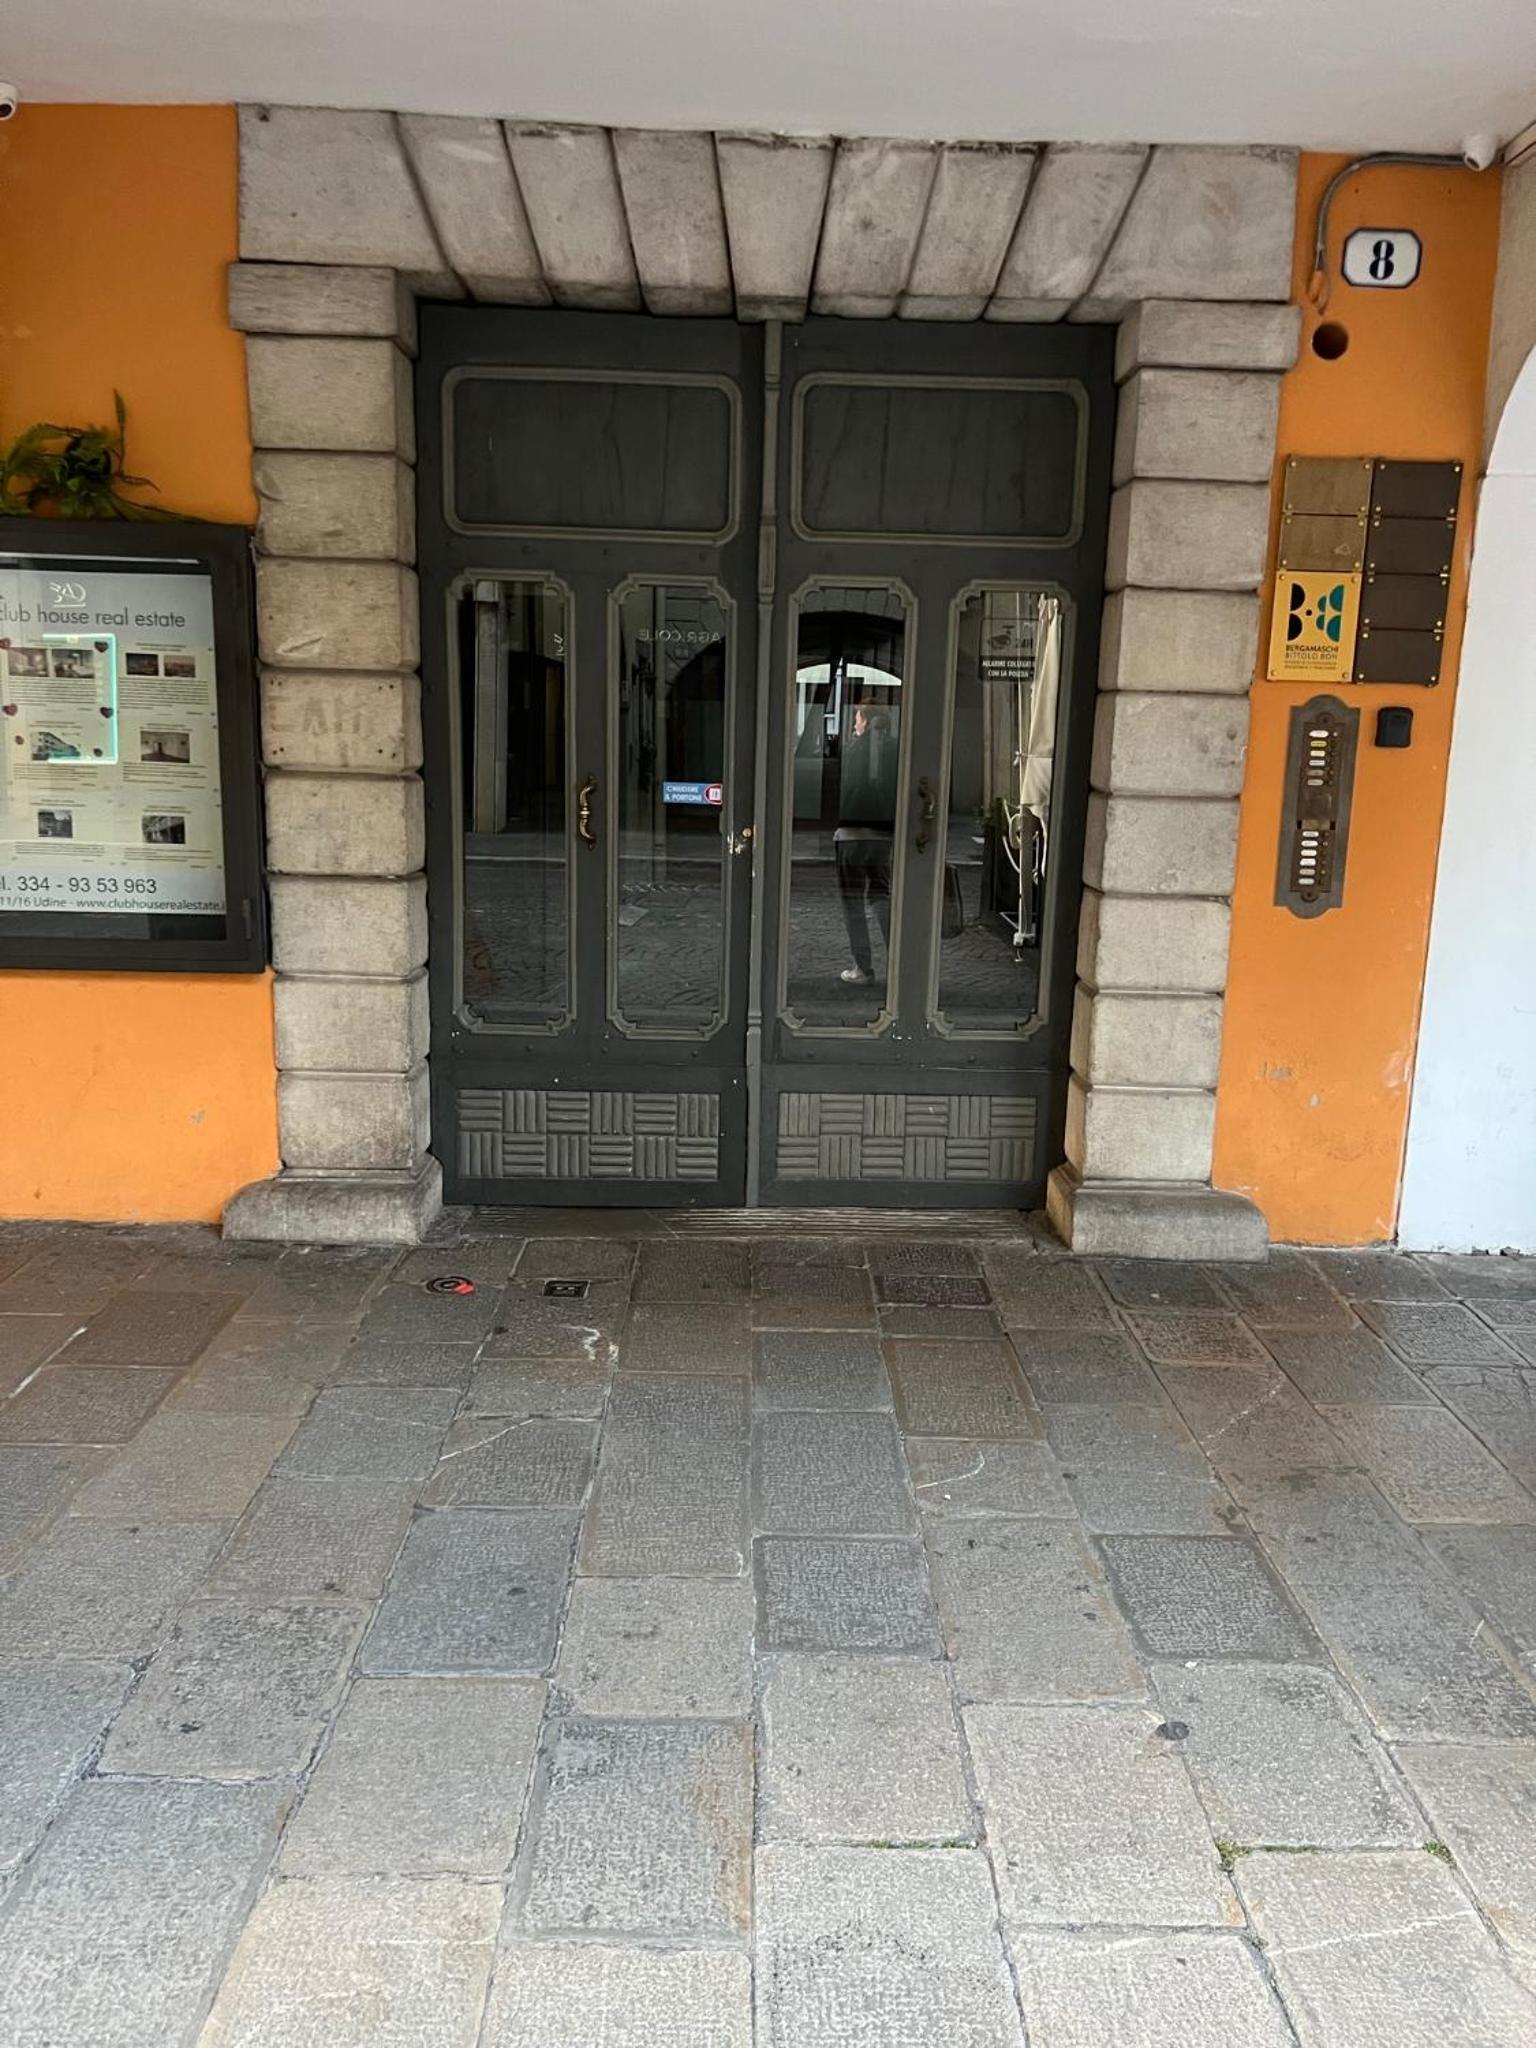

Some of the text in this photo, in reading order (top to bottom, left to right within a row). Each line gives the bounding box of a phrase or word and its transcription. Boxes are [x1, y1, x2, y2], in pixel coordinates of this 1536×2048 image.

[1369, 240, 1394, 280] 8
[37, 603, 89, 625] house
[96, 606, 129, 625] real
[135, 611, 186, 627] estate
[17, 876, 50, 891] 334
[69, 877, 91, 892] 93
[97, 878, 119, 892] 53
[124, 878, 157, 893] 963
[33, 897, 66, 907] Udine
